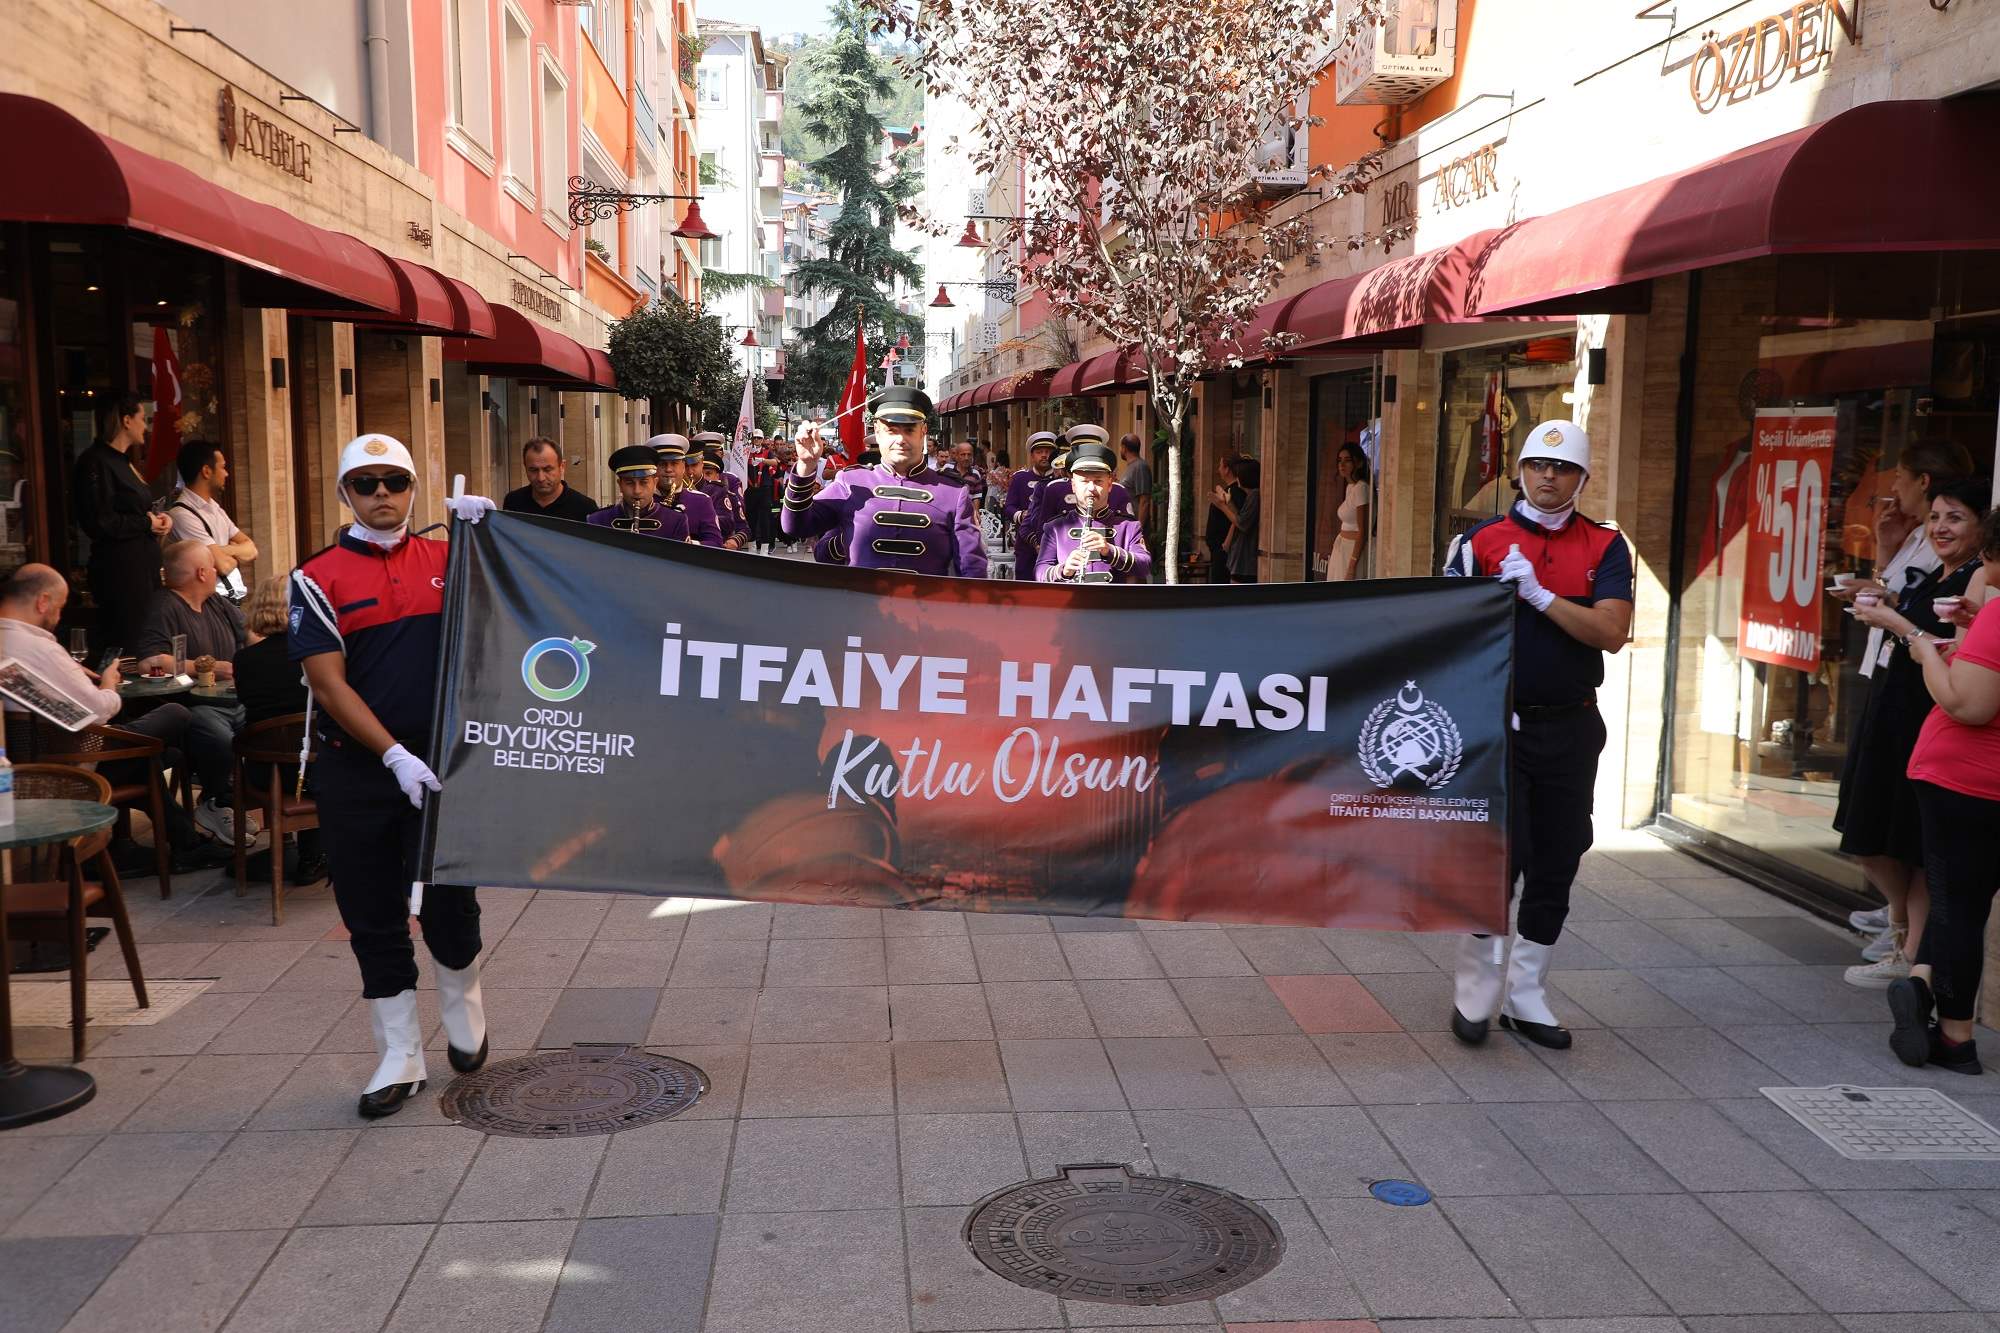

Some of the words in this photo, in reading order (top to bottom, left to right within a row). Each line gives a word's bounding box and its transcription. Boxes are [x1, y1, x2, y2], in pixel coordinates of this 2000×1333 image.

[1690, 0, 1858, 106] ÖZDEN
[239, 107, 312, 184] KYBELE
[1432, 144, 1498, 210] ACAR
[1759, 429, 1784, 452] Seçili
[1786, 426, 1832, 448] Ürünlerde
[1757, 459, 1822, 607] %50
[1745, 612, 1815, 661] İNDİRİM
[659, 622, 968, 714] İTFAİYE
[999, 660, 1329, 732] HAFTASI
[463, 720, 636, 757] BÜYÜKŞEHİR
[523, 707, 583, 728] ORDU
[493, 749, 605, 775] BELEDİYESİ
[827, 728, 985, 809] Kutlu
[992, 726, 1160, 803] Olsun
[1330, 793, 1361, 803] ORDU
[1362, 794, 1430, 806] BÜYÜKŞEHİR
[1430, 797, 1489, 808] BELEDİYESİ
[1330, 803, 1370, 817] İTFAİYE
[1373, 806, 1416, 819] DAİRESİ
[1419, 808, 1489, 822] BAŞKANLIĞI
